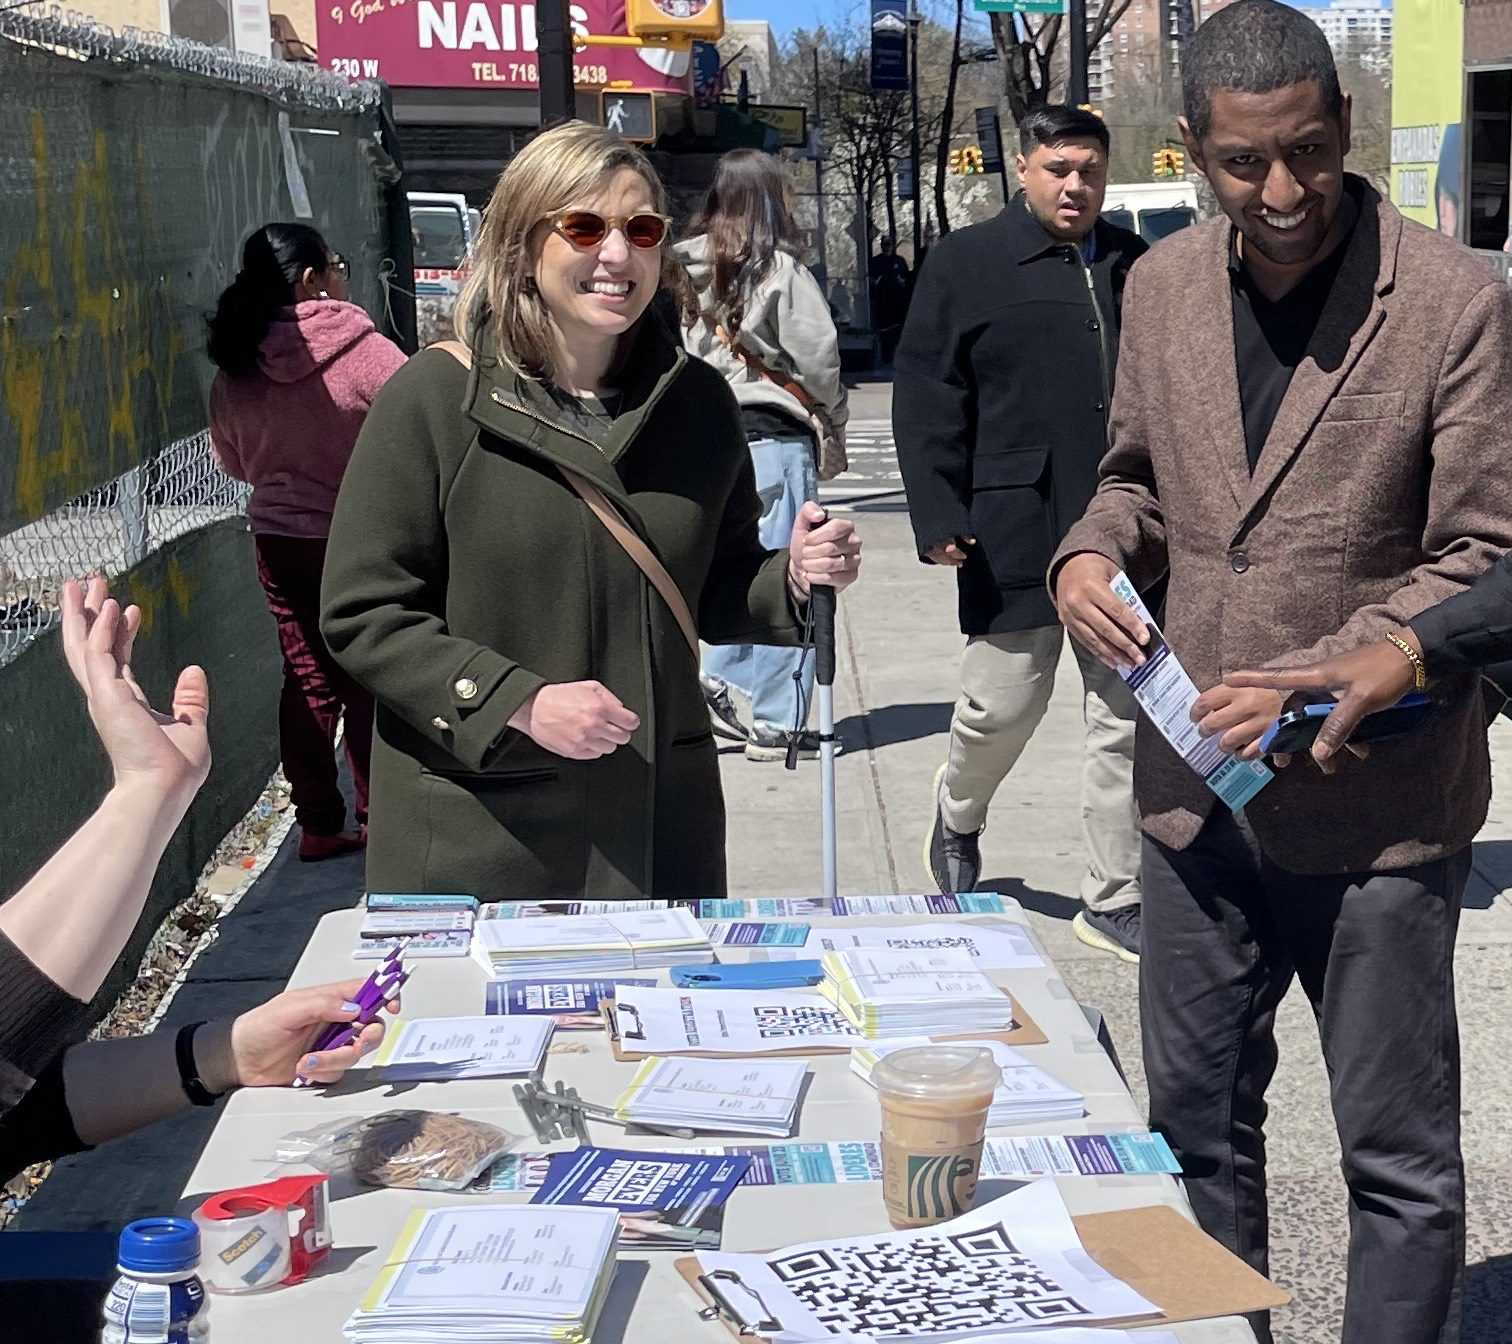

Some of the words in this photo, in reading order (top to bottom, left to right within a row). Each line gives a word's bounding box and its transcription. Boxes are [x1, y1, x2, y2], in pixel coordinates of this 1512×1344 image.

[363, 59, 379, 78] W
[582, 1159, 633, 1202] MORGAN
[612, 1163, 662, 1202] EVERS
[222, 1227, 264, 1263] Scotch
